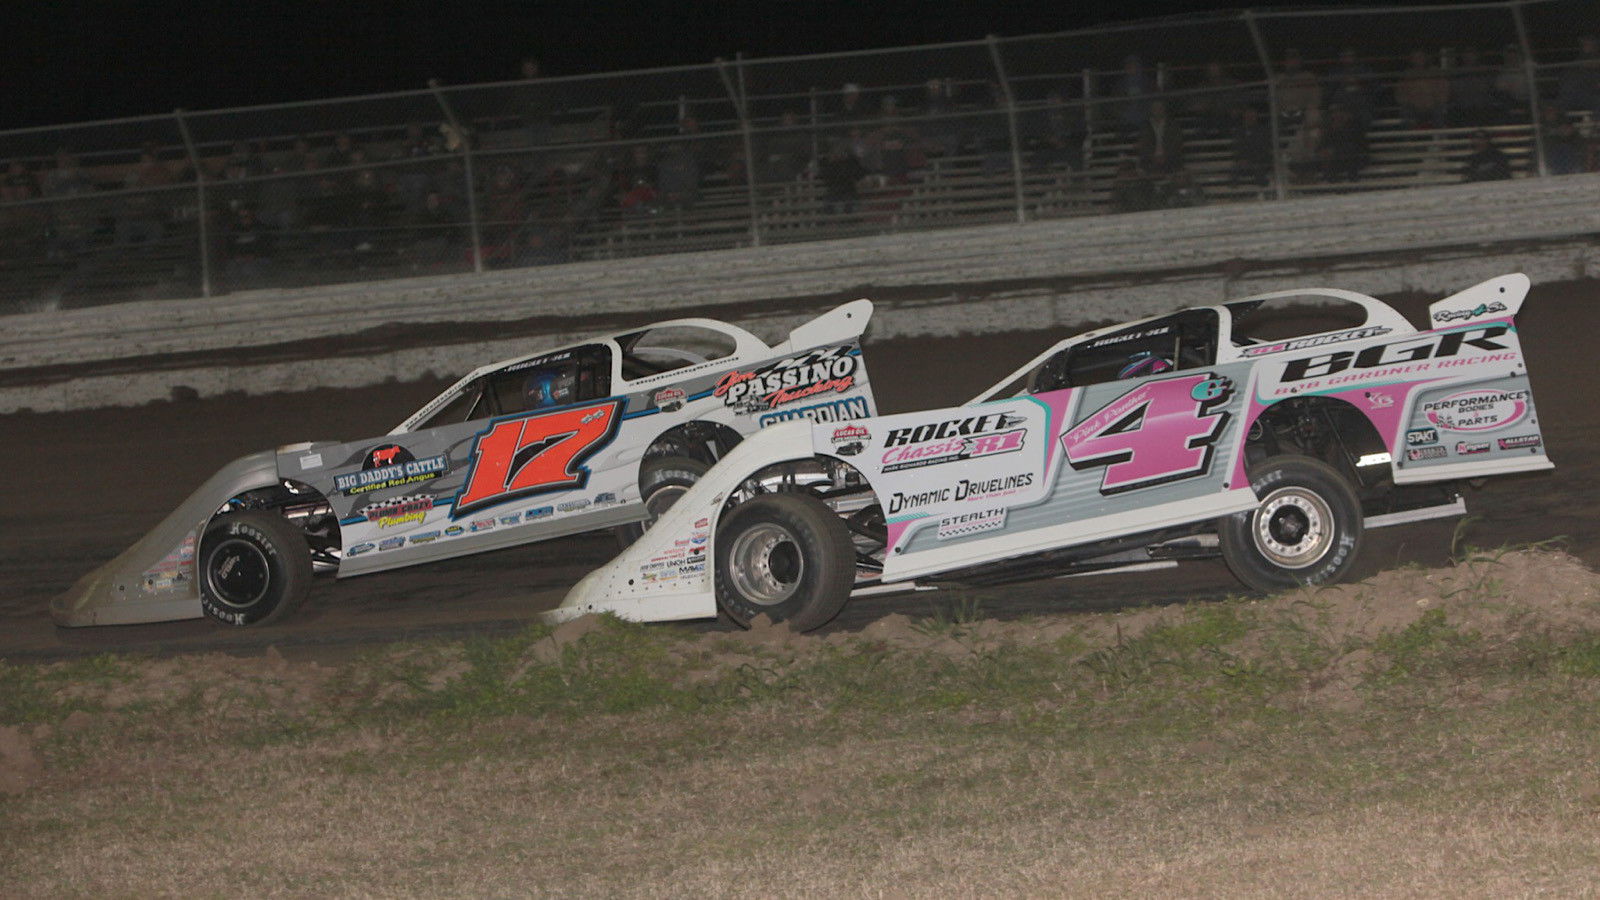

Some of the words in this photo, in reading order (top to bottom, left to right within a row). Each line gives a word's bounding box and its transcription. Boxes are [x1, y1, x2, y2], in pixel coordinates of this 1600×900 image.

[1280, 327, 1510, 382] BGR
[1328, 363, 1430, 385] GARDNER
[1437, 352, 1517, 369] RACING
[725, 355, 857, 406] PASSINO
[763, 376, 854, 408] Trucking
[1424, 392, 1525, 411] PERFORMANCE
[1458, 404, 1494, 413] BODIES
[884, 409, 1014, 448] ROCKET
[1060, 372, 1231, 496] 4
[1458, 416, 1498, 426] PARTS
[453, 398, 622, 513] 17
[882, 438, 966, 464] Chassis
[1505, 435, 1540, 444] ALLSTAR
[337, 475, 357, 489] BIG
[360, 466, 404, 484] DADDY'S
[406, 457, 445, 473] CATTLE
[406, 472, 436, 484] Angus
[889, 488, 951, 514] DYNAMIC
[955, 473, 1034, 501] DRIVELINES
[377, 511, 427, 529] Plumbing
[941, 508, 1005, 527] STEALTH
[230, 522, 278, 557] Hoosier
